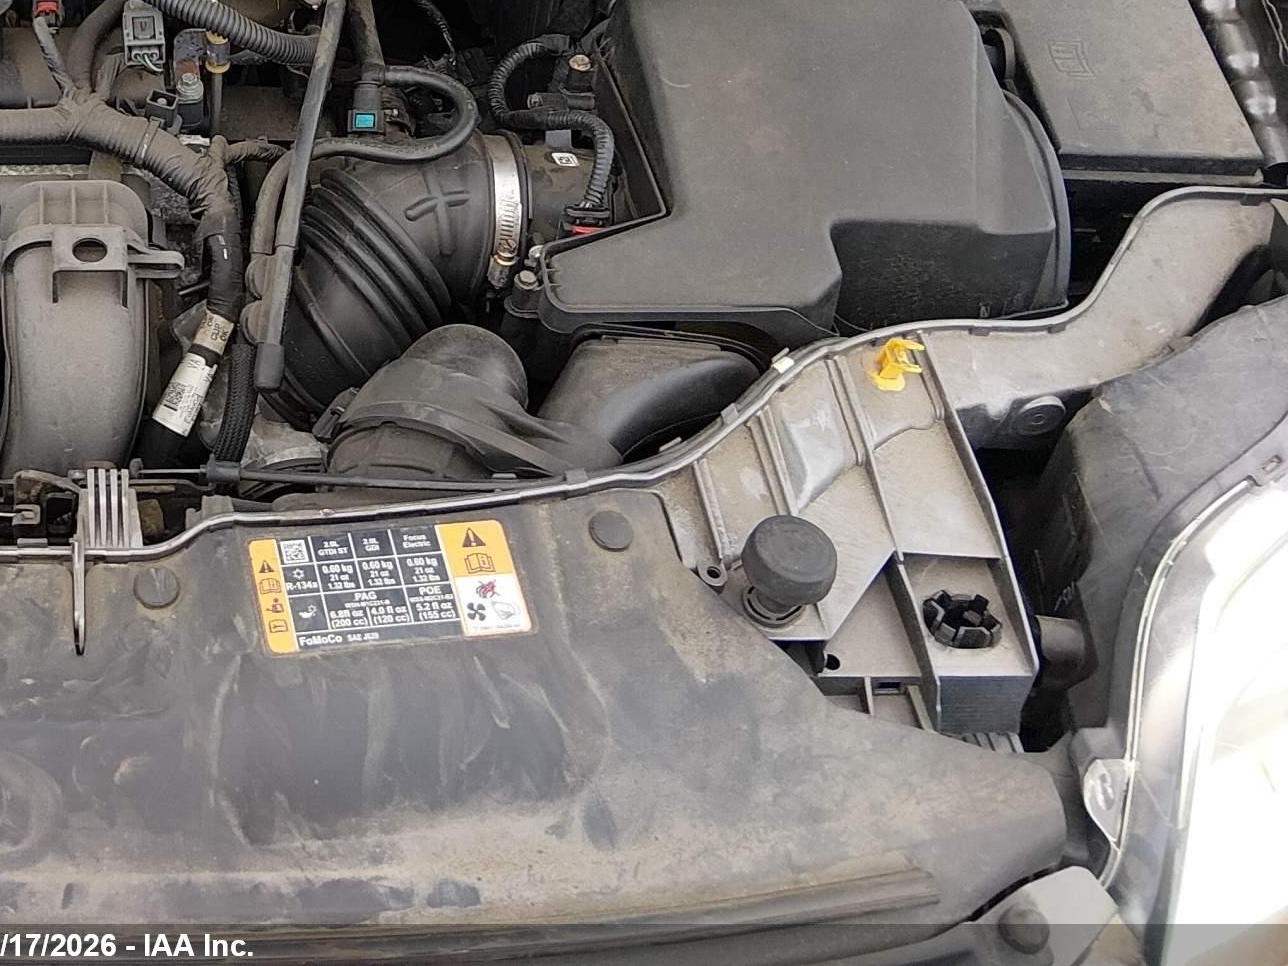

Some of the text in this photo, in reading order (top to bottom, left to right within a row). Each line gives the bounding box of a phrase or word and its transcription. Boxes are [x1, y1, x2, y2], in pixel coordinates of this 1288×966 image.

[403, 539, 432, 548] Electric
[381, 560, 394, 571] kg
[426, 557, 438, 566] kg
[342, 563, 353, 574] kg
[330, 573, 350, 582] 21 oz
[370, 570, 379, 578] 21
[286, 581, 318, 591] R-134a
[419, 586, 442, 596] POE
[354, 591, 377, 601] PAG
[371, 604, 407, 615] 4.0 fl oz
[416, 600, 453, 611] 5.2 fl oz
[352, 608, 364, 618] oz
[418, 609, 456, 620] (155 cc)
[331, 616, 368, 629] (200 cc)
[372, 612, 410, 625] (120 cc)
[299, 634, 343, 646] FoMoCo
